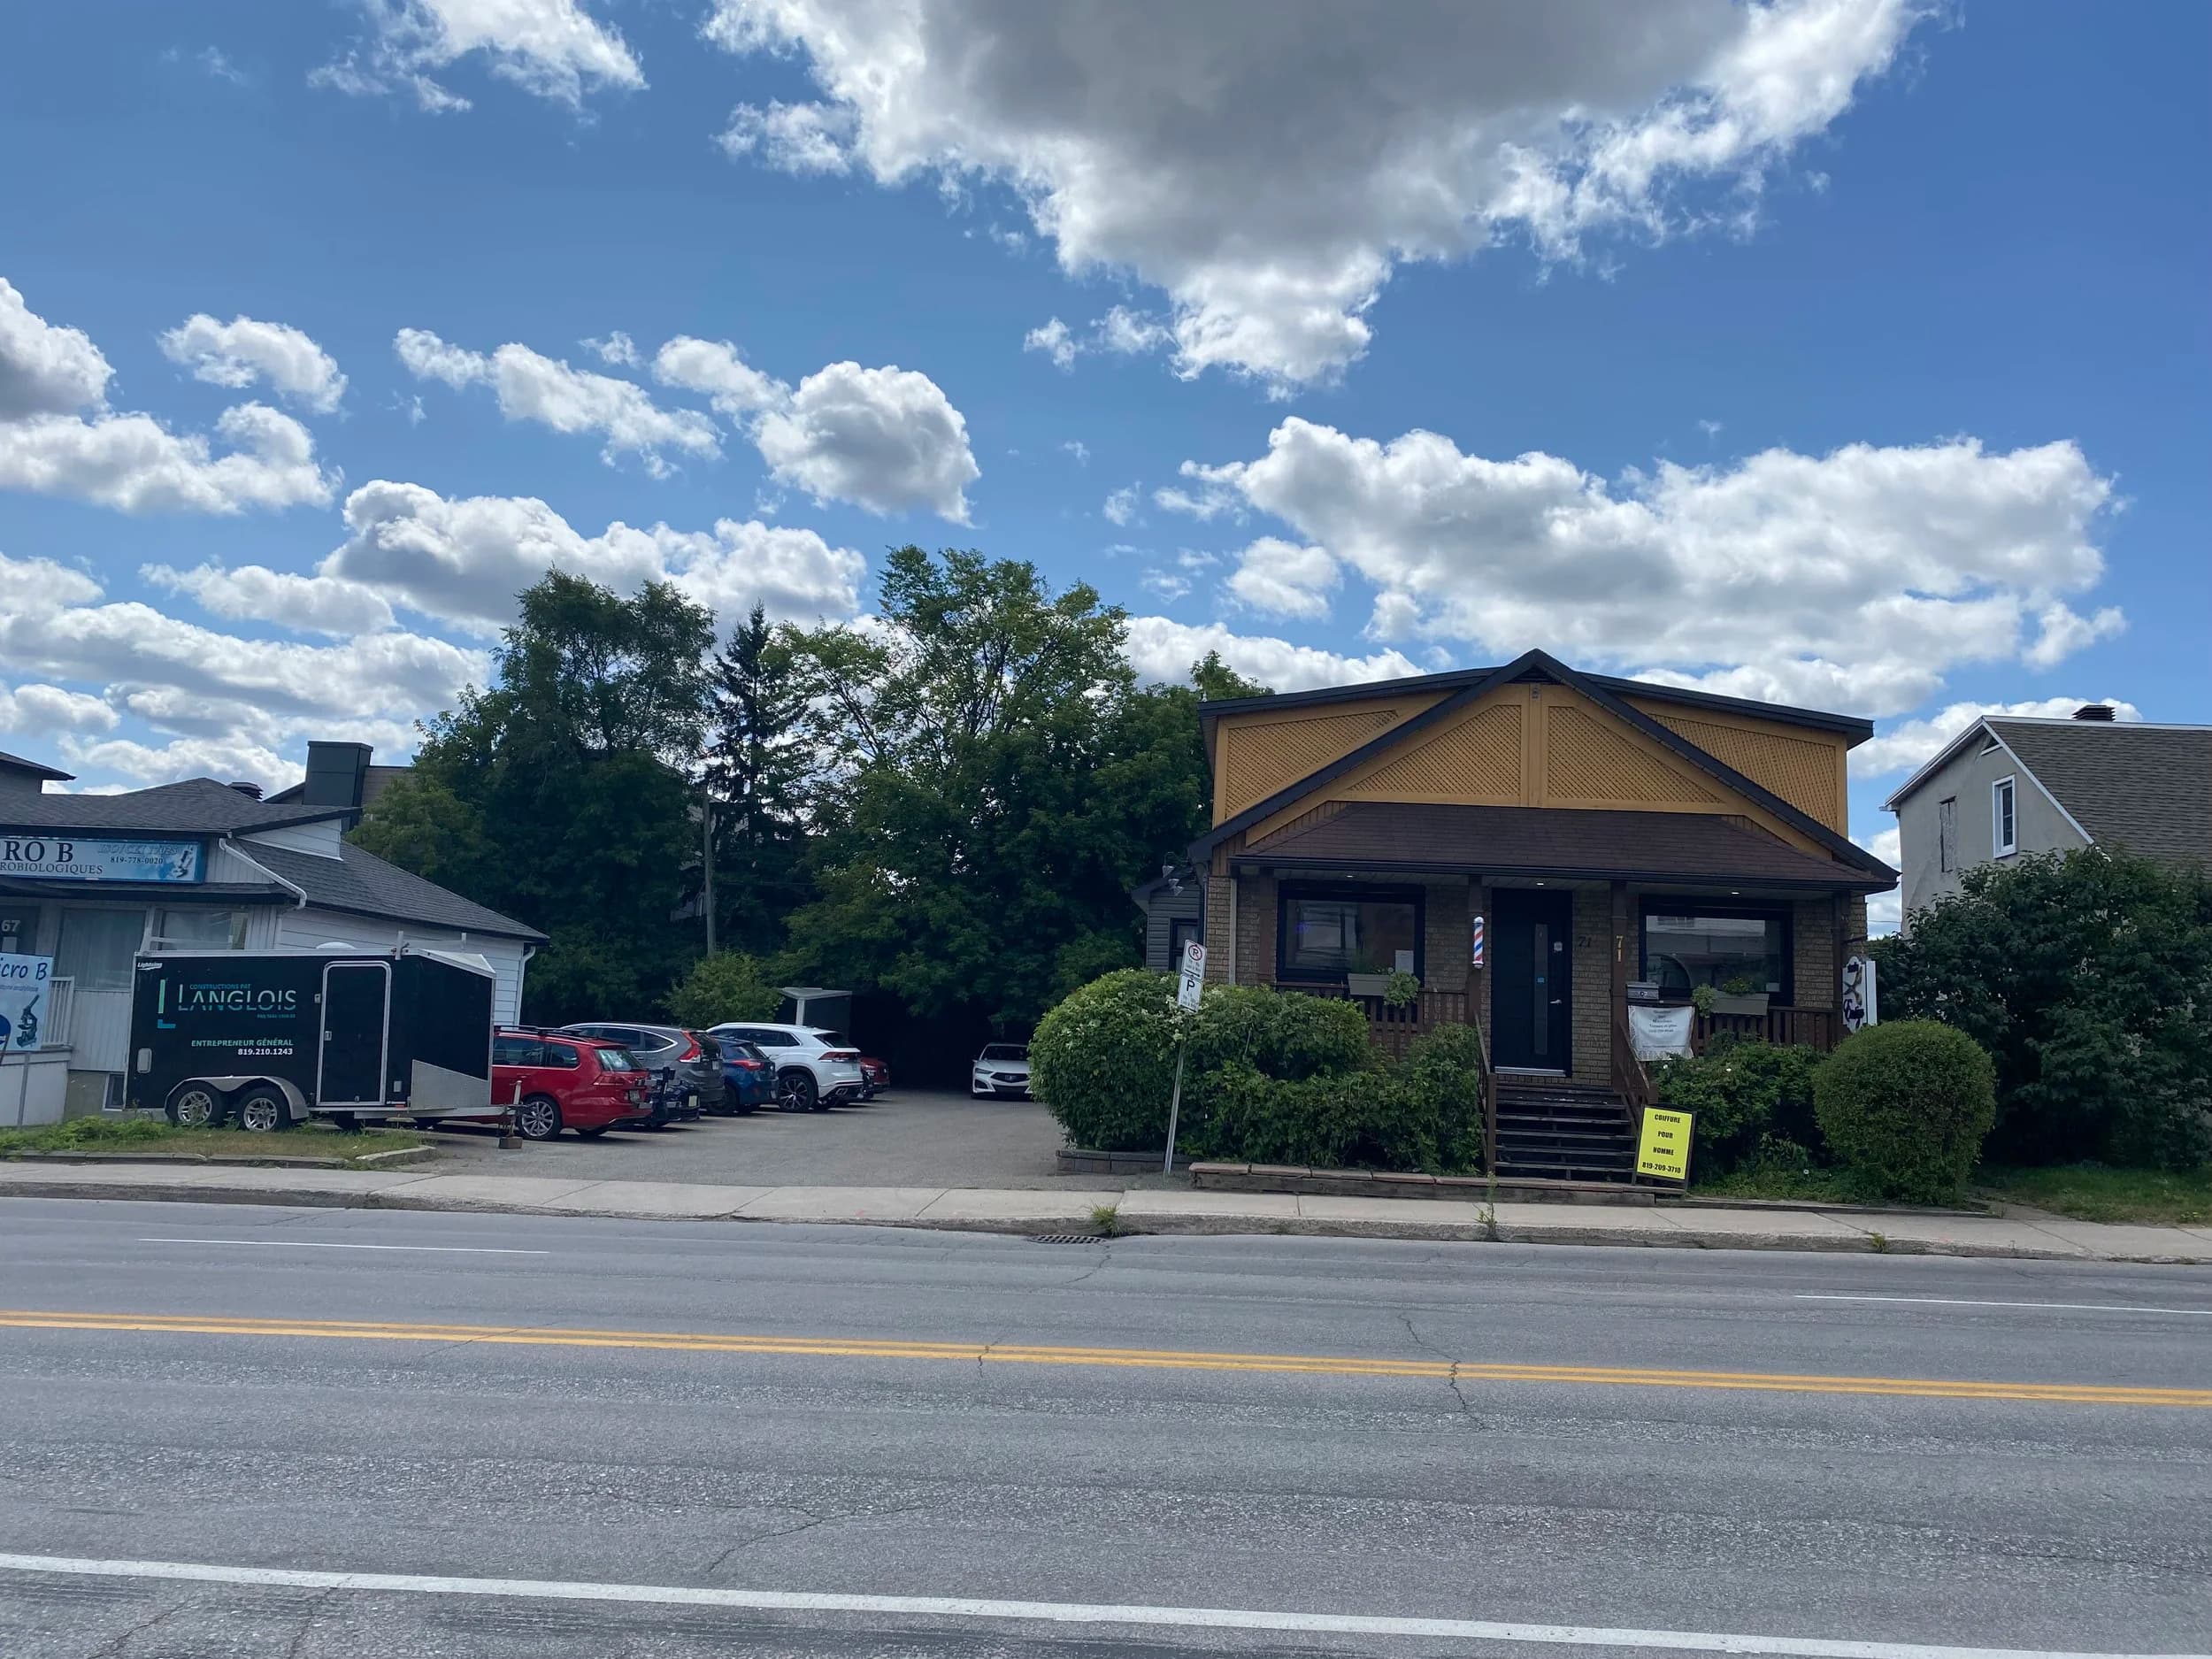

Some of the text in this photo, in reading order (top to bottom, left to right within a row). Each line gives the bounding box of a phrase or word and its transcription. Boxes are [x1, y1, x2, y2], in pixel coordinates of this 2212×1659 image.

[55, 842, 73, 863] B
[110, 856, 164, 864] 819-778-0020
[35, 962, 48, 981] B
[1187, 979, 1195, 992] P
[178, 984, 297, 1011] LANGLOIS
[256, 1037, 294, 1047] GÉNÉRAL
[1654, 1114, 1681, 1124] COIFFURE
[1653, 1147, 1675, 1156] HOMME
[1641, 1162, 1681, 1174] 819-209-3710
